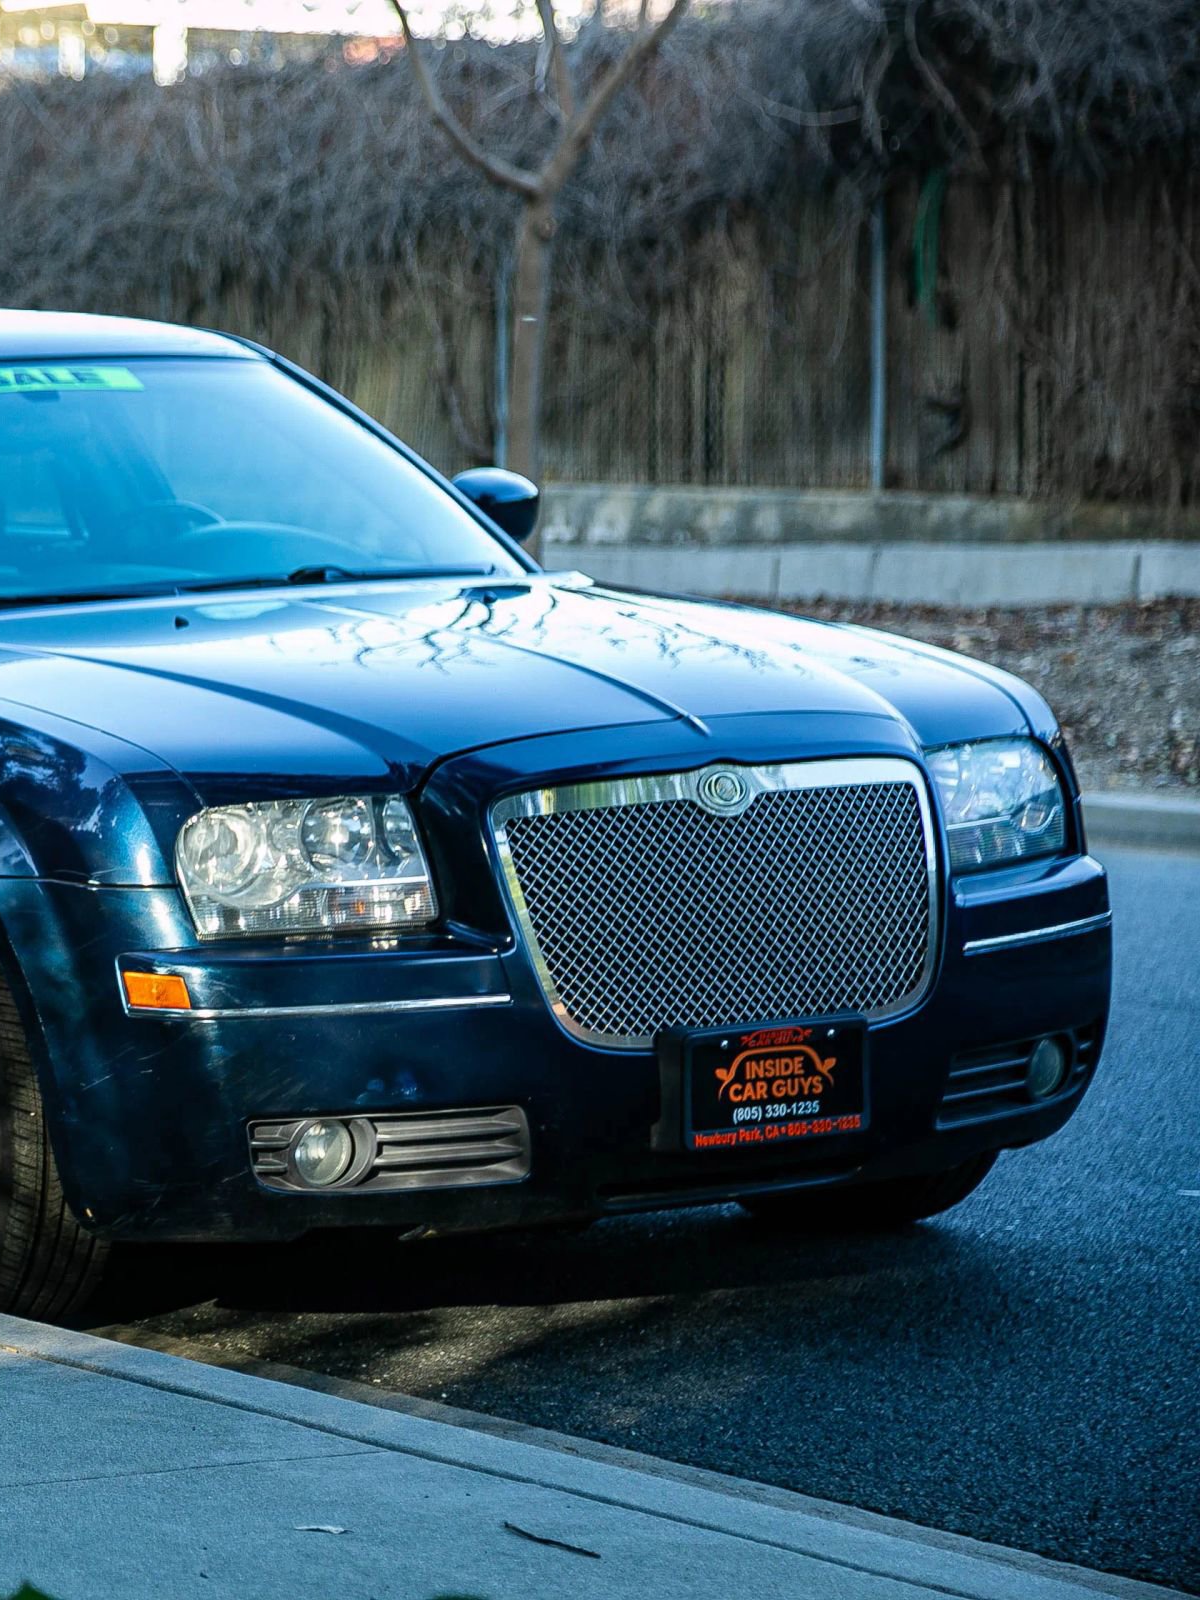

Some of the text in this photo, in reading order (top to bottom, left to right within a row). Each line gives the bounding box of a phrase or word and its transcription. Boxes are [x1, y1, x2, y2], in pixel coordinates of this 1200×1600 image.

[745, 1056, 804, 1079] INSIDE
[729, 1075, 823, 1102] CAR GUYS
[732, 1100, 820, 1124] (805) 330-1235
[695, 1132, 736, 1148] Newbury
